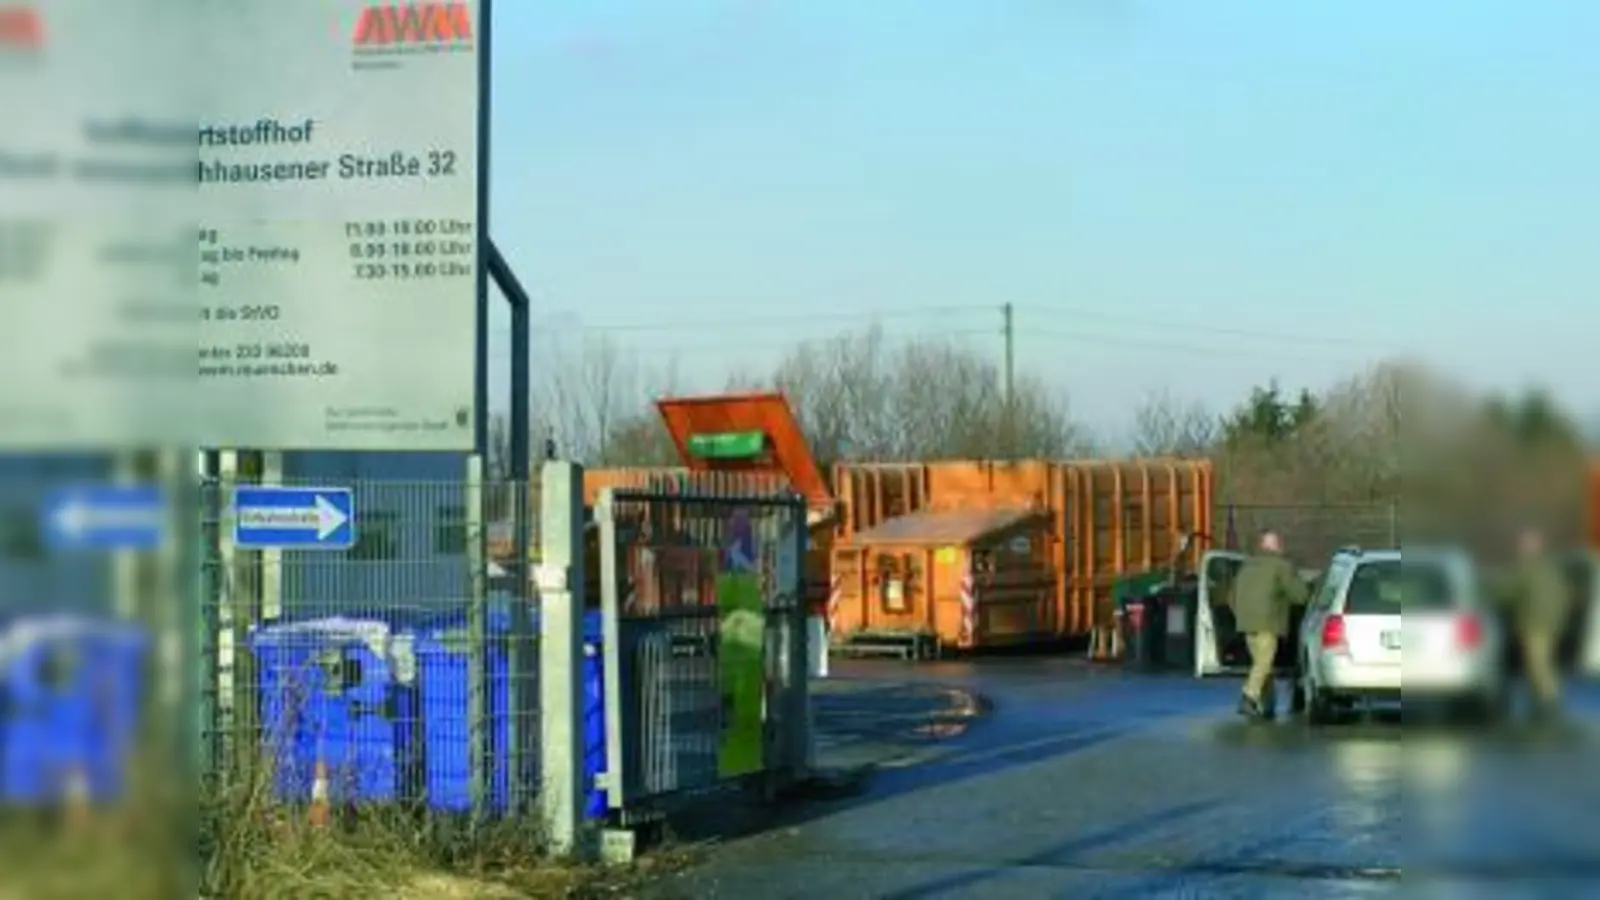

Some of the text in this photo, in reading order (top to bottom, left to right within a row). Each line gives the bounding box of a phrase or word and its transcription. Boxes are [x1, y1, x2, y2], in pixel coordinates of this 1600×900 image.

[352, 3, 471, 45] AWM
[339, 151, 420, 178] Straße
[428, 149, 457, 176] 32
